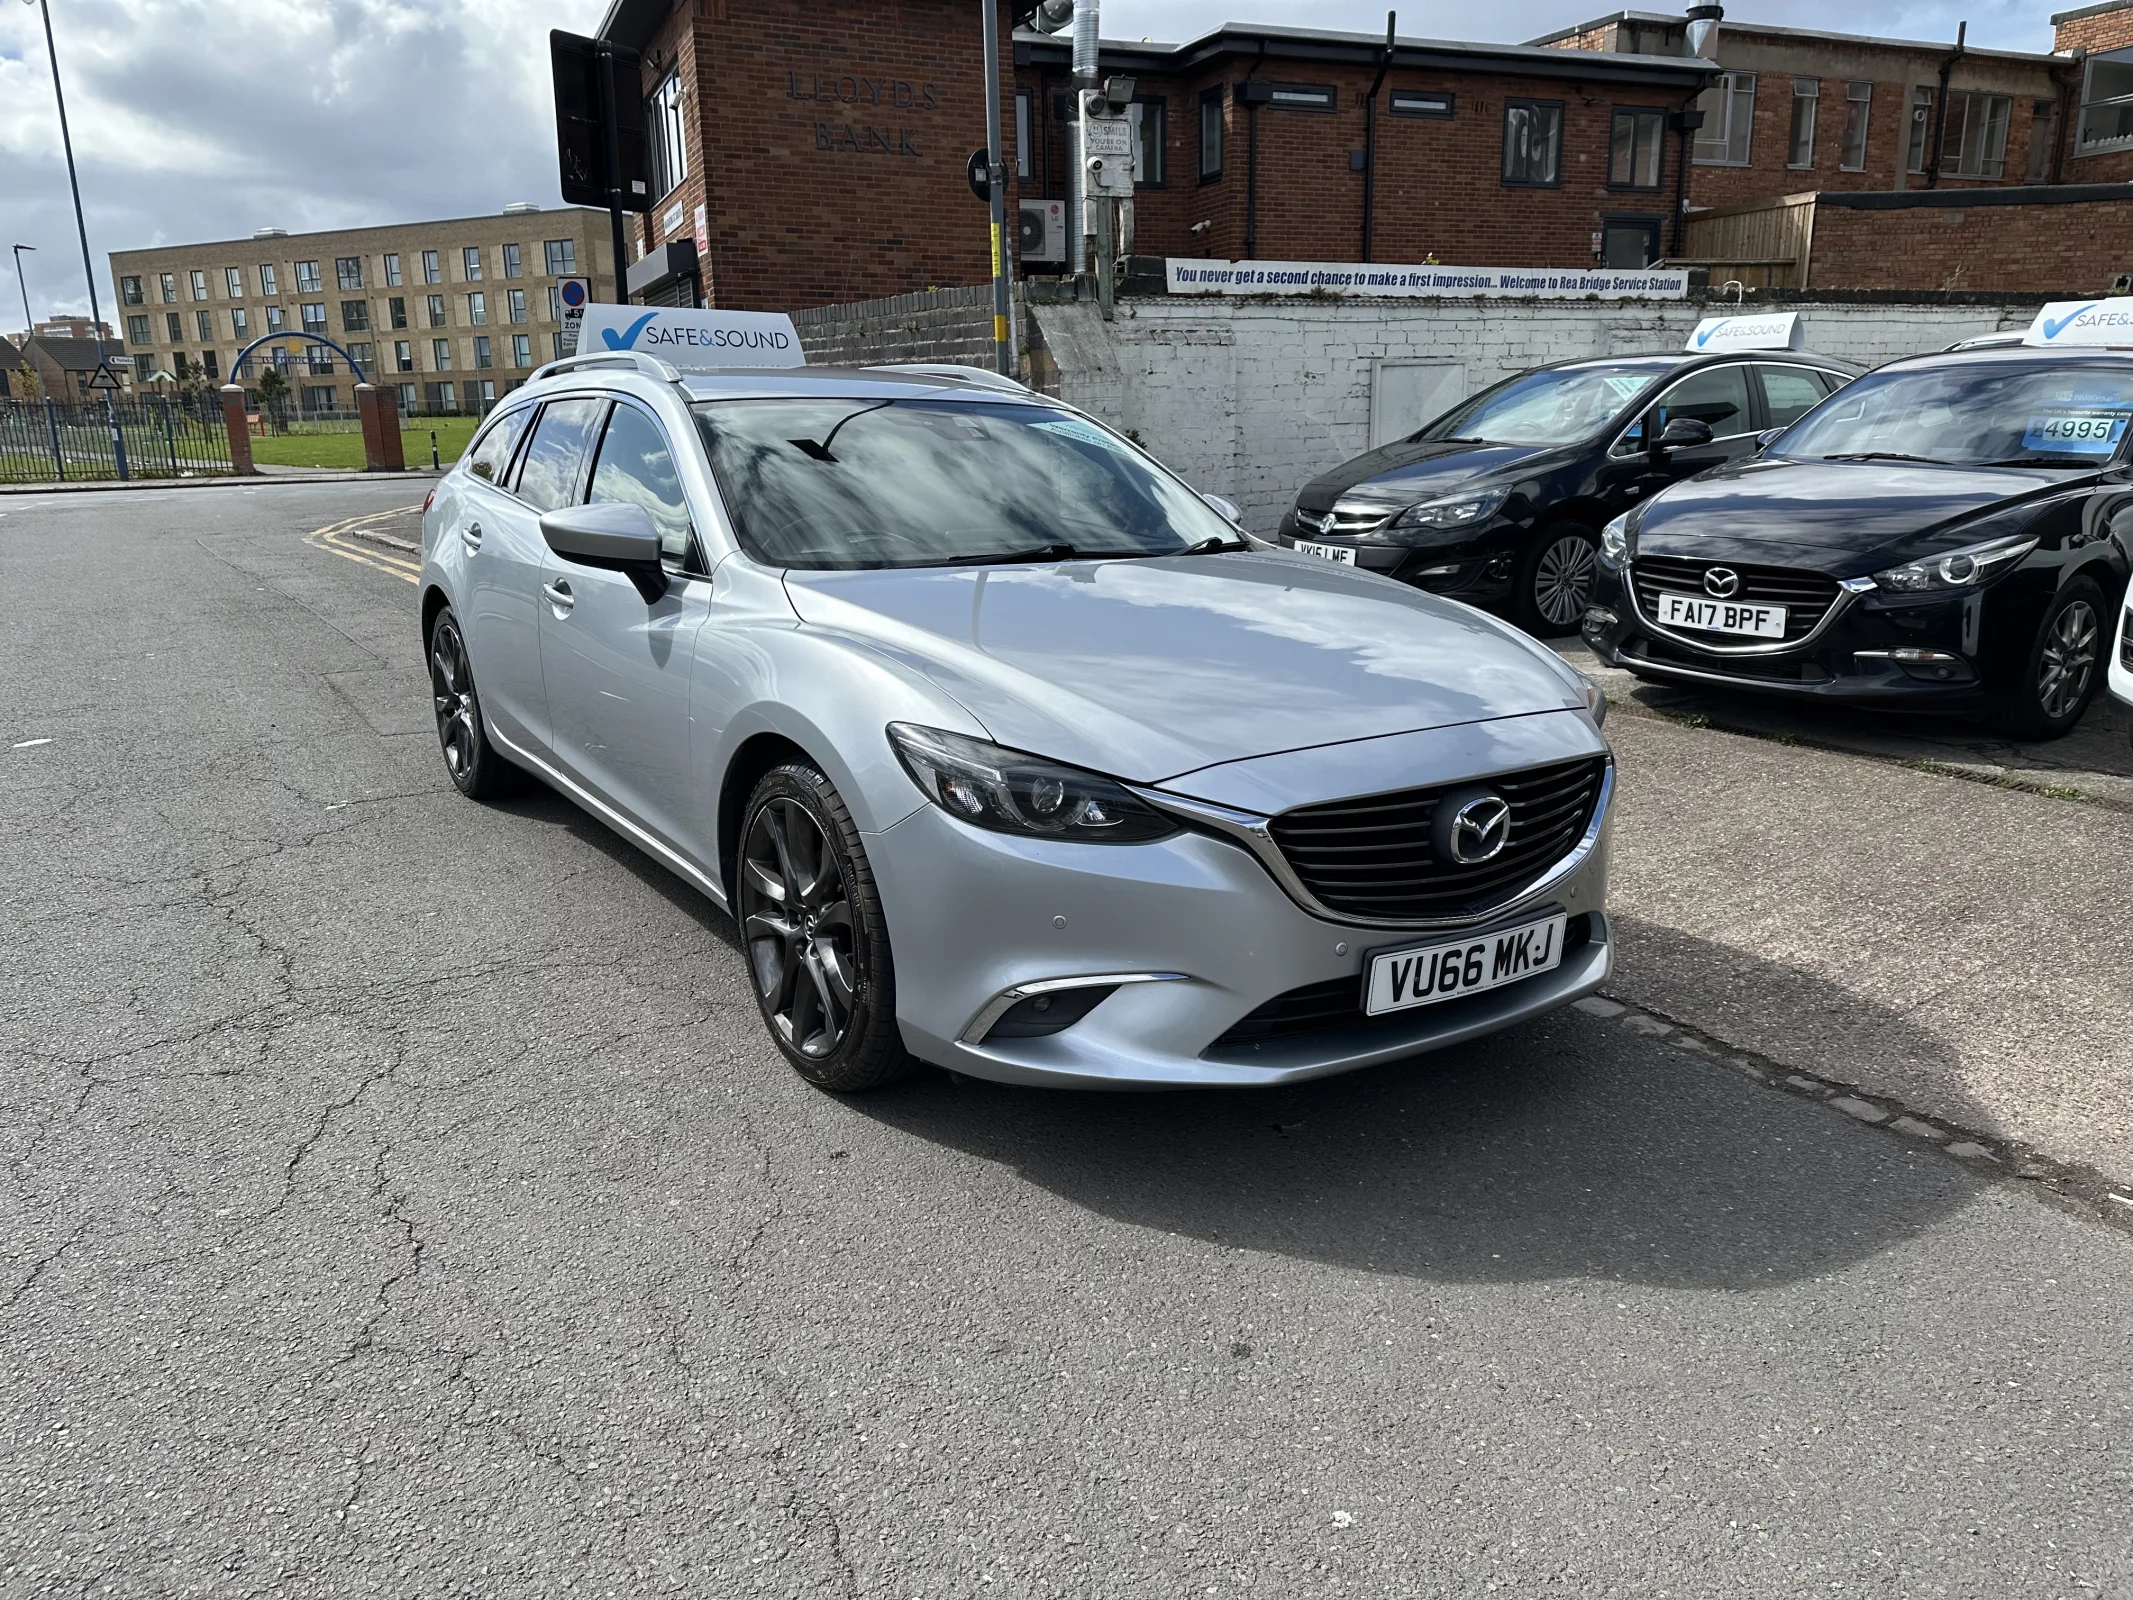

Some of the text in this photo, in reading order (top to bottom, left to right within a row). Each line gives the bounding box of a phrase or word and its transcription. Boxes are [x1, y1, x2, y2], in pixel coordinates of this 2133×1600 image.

[790, 71, 937, 110] LLOYDS
[814, 121, 923, 157] BANK
[1103, 126, 1127, 136] SMILE
[1176, 266, 1197, 282] You
[1199, 270, 1234, 283] never
[1235, 270, 1255, 285] get
[1257, 271, 1264, 284] a
[1266, 270, 1309, 284] second
[1310, 271, 1351, 285] chance
[1354, 272, 1366, 285] to
[1367, 272, 1398, 286] make
[1399, 275, 1407, 286] a
[1408, 272, 1431, 287] first
[1500, 275, 1546, 289] Welcome
[1548, 276, 1558, 289] to
[1560, 276, 1578, 289] Rea
[1579, 276, 1611, 291] Bridge
[1612, 277, 1647, 290] Service
[1648, 277, 1681, 291] Station
[646, 326, 789, 349] SAFE&SOUND
[1716, 323, 1786, 338] SAFE&SOUND
[1670, 600, 1770, 631] FA17 BPF
[1390, 923, 1554, 1003] VU66 MKJ
